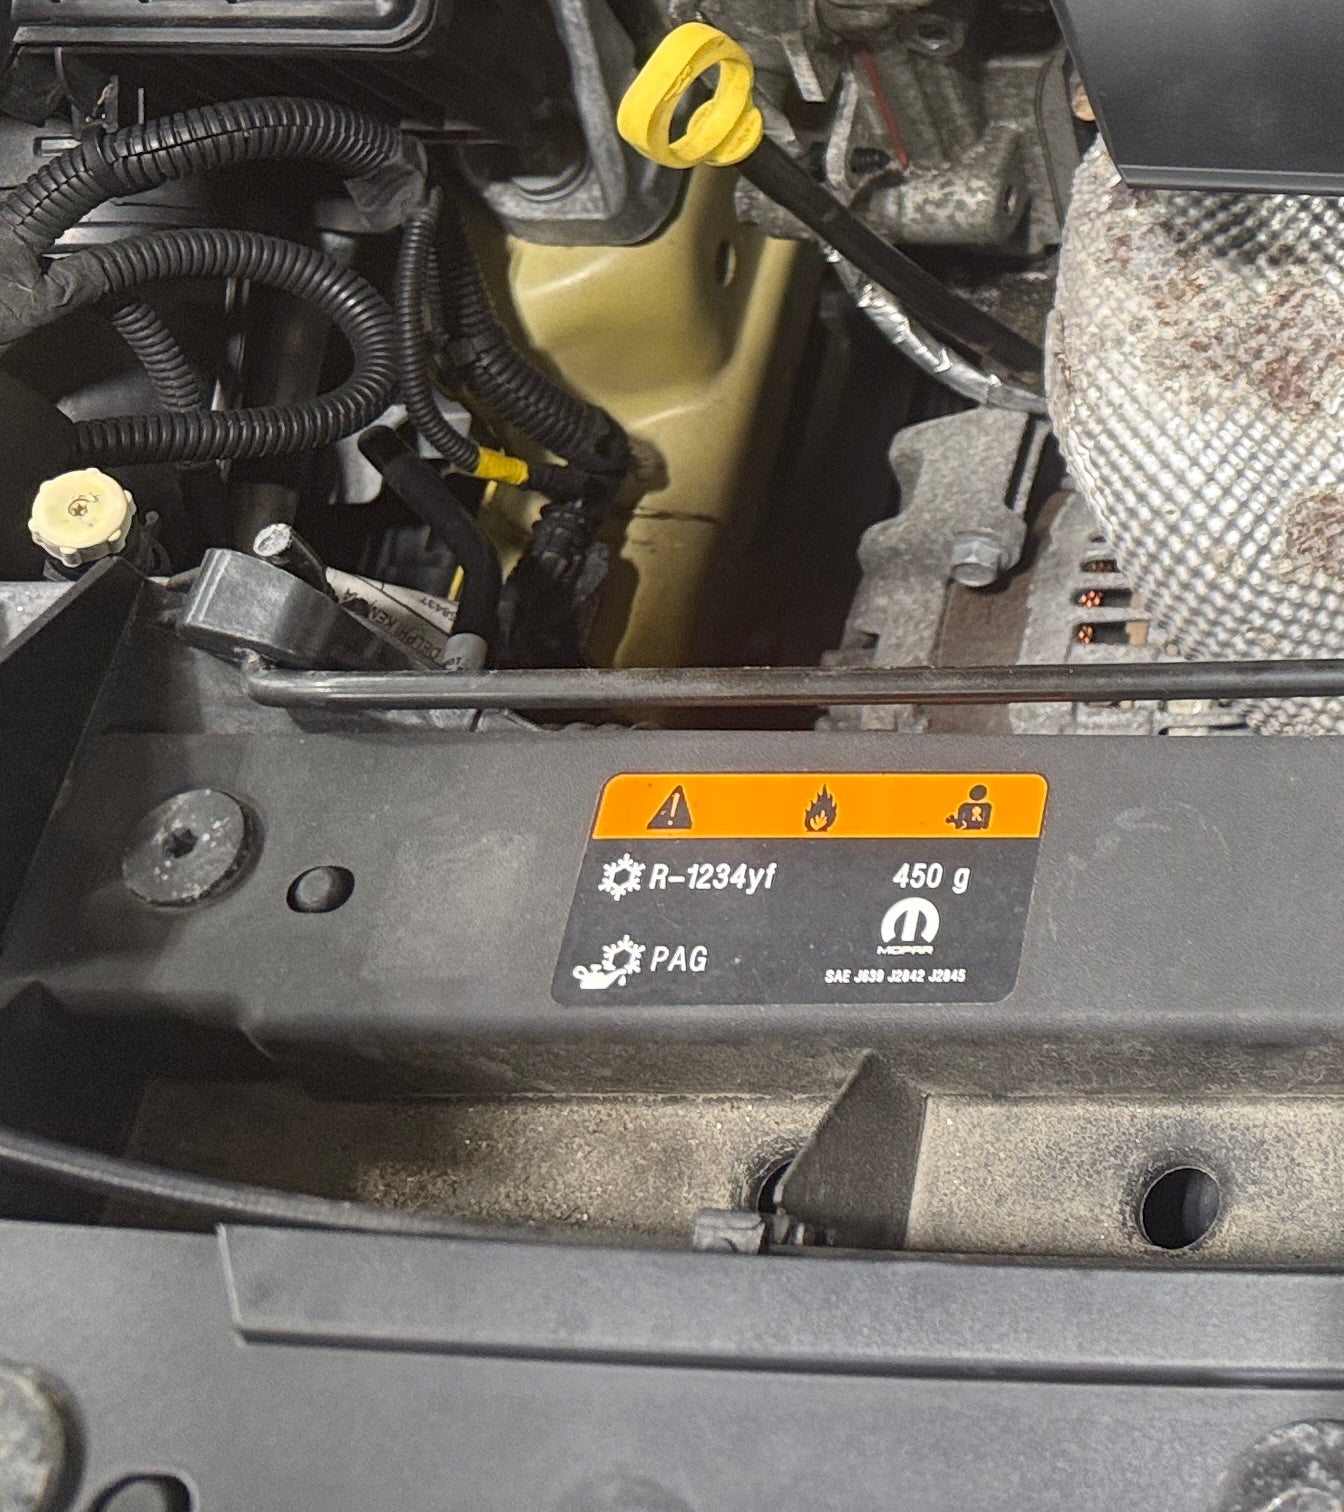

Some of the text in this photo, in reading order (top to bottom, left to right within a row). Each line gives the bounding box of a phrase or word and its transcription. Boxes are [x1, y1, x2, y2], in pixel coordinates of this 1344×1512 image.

[648, 862, 971, 896] R-1234yf 450 g
[649, 945, 709, 973] PAG
[876, 945, 934, 956] MOPAR
[824, 968, 852, 984] SAE
